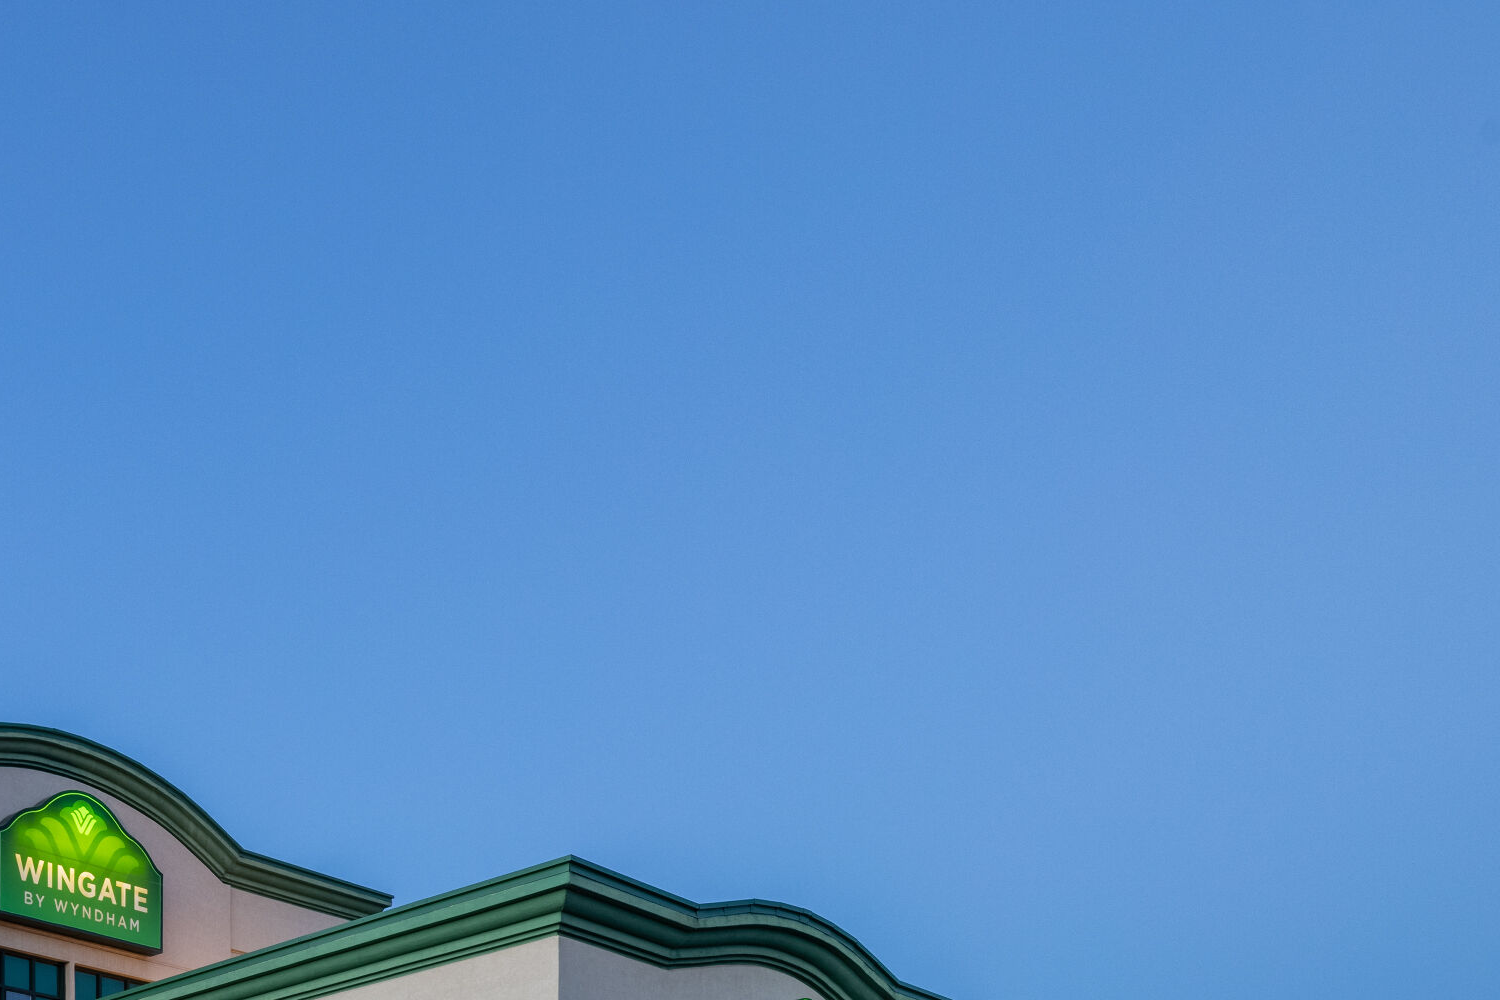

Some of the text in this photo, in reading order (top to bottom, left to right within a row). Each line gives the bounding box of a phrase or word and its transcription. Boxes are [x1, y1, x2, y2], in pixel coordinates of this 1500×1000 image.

[15, 853, 148, 913] WINGATE
[24, 891, 140, 933] BY WYNDHAM
